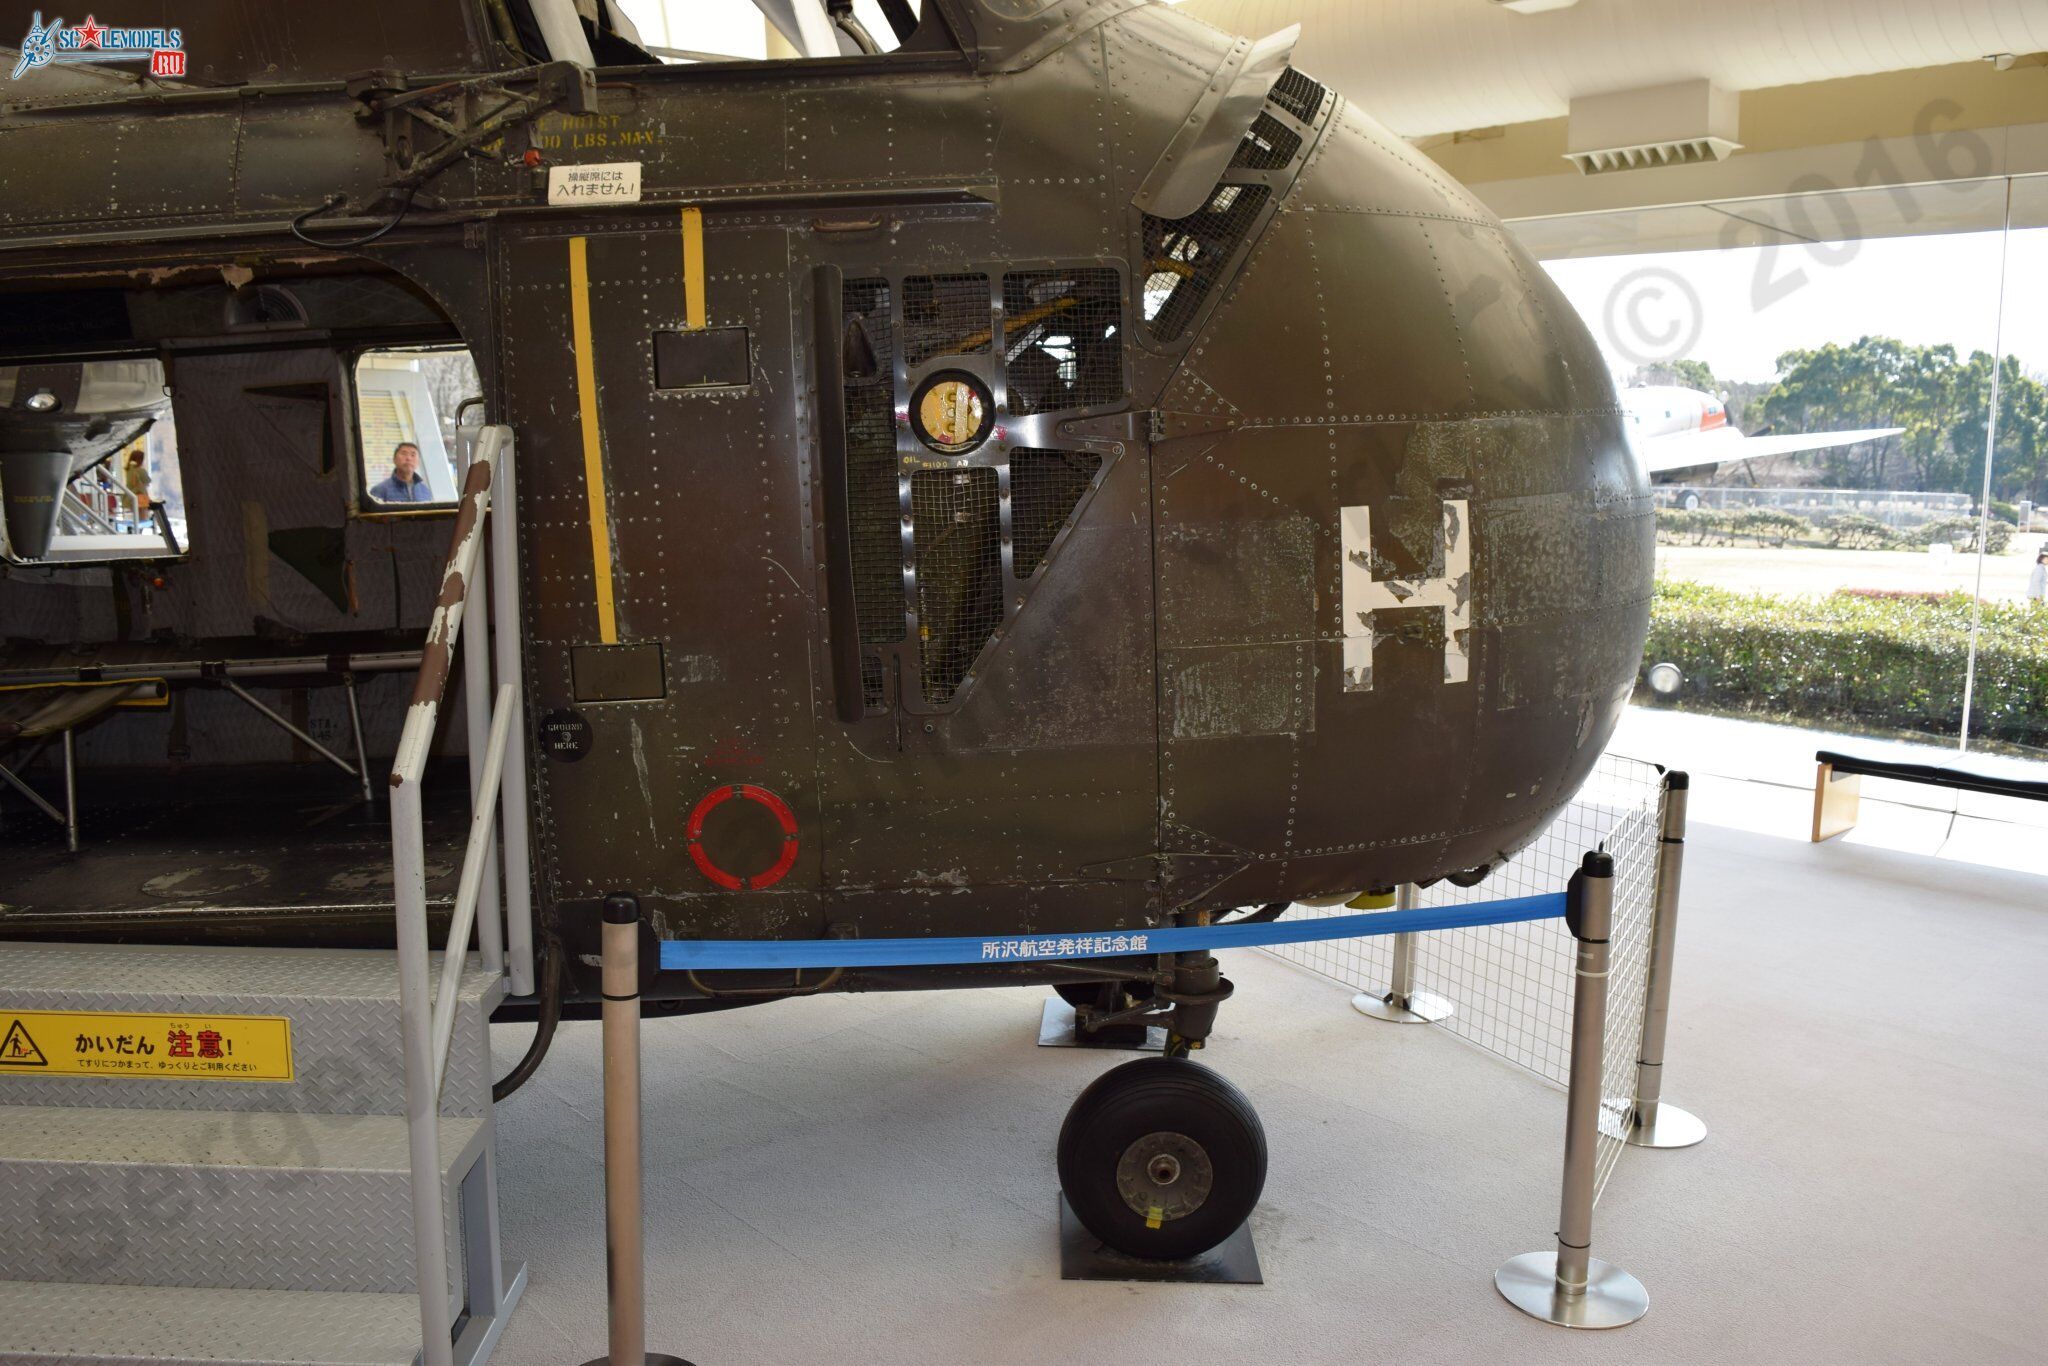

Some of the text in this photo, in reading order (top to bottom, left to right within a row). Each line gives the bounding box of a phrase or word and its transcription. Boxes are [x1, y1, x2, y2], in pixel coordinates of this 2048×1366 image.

[903, 455, 920, 464] OIL
[547, 723, 583, 731] GROUND
[554, 742, 580, 750] HERE
[981, 934, 1149, 960] 所沢航空発祥記念館
[75, 1033, 155, 1055] かいだん
